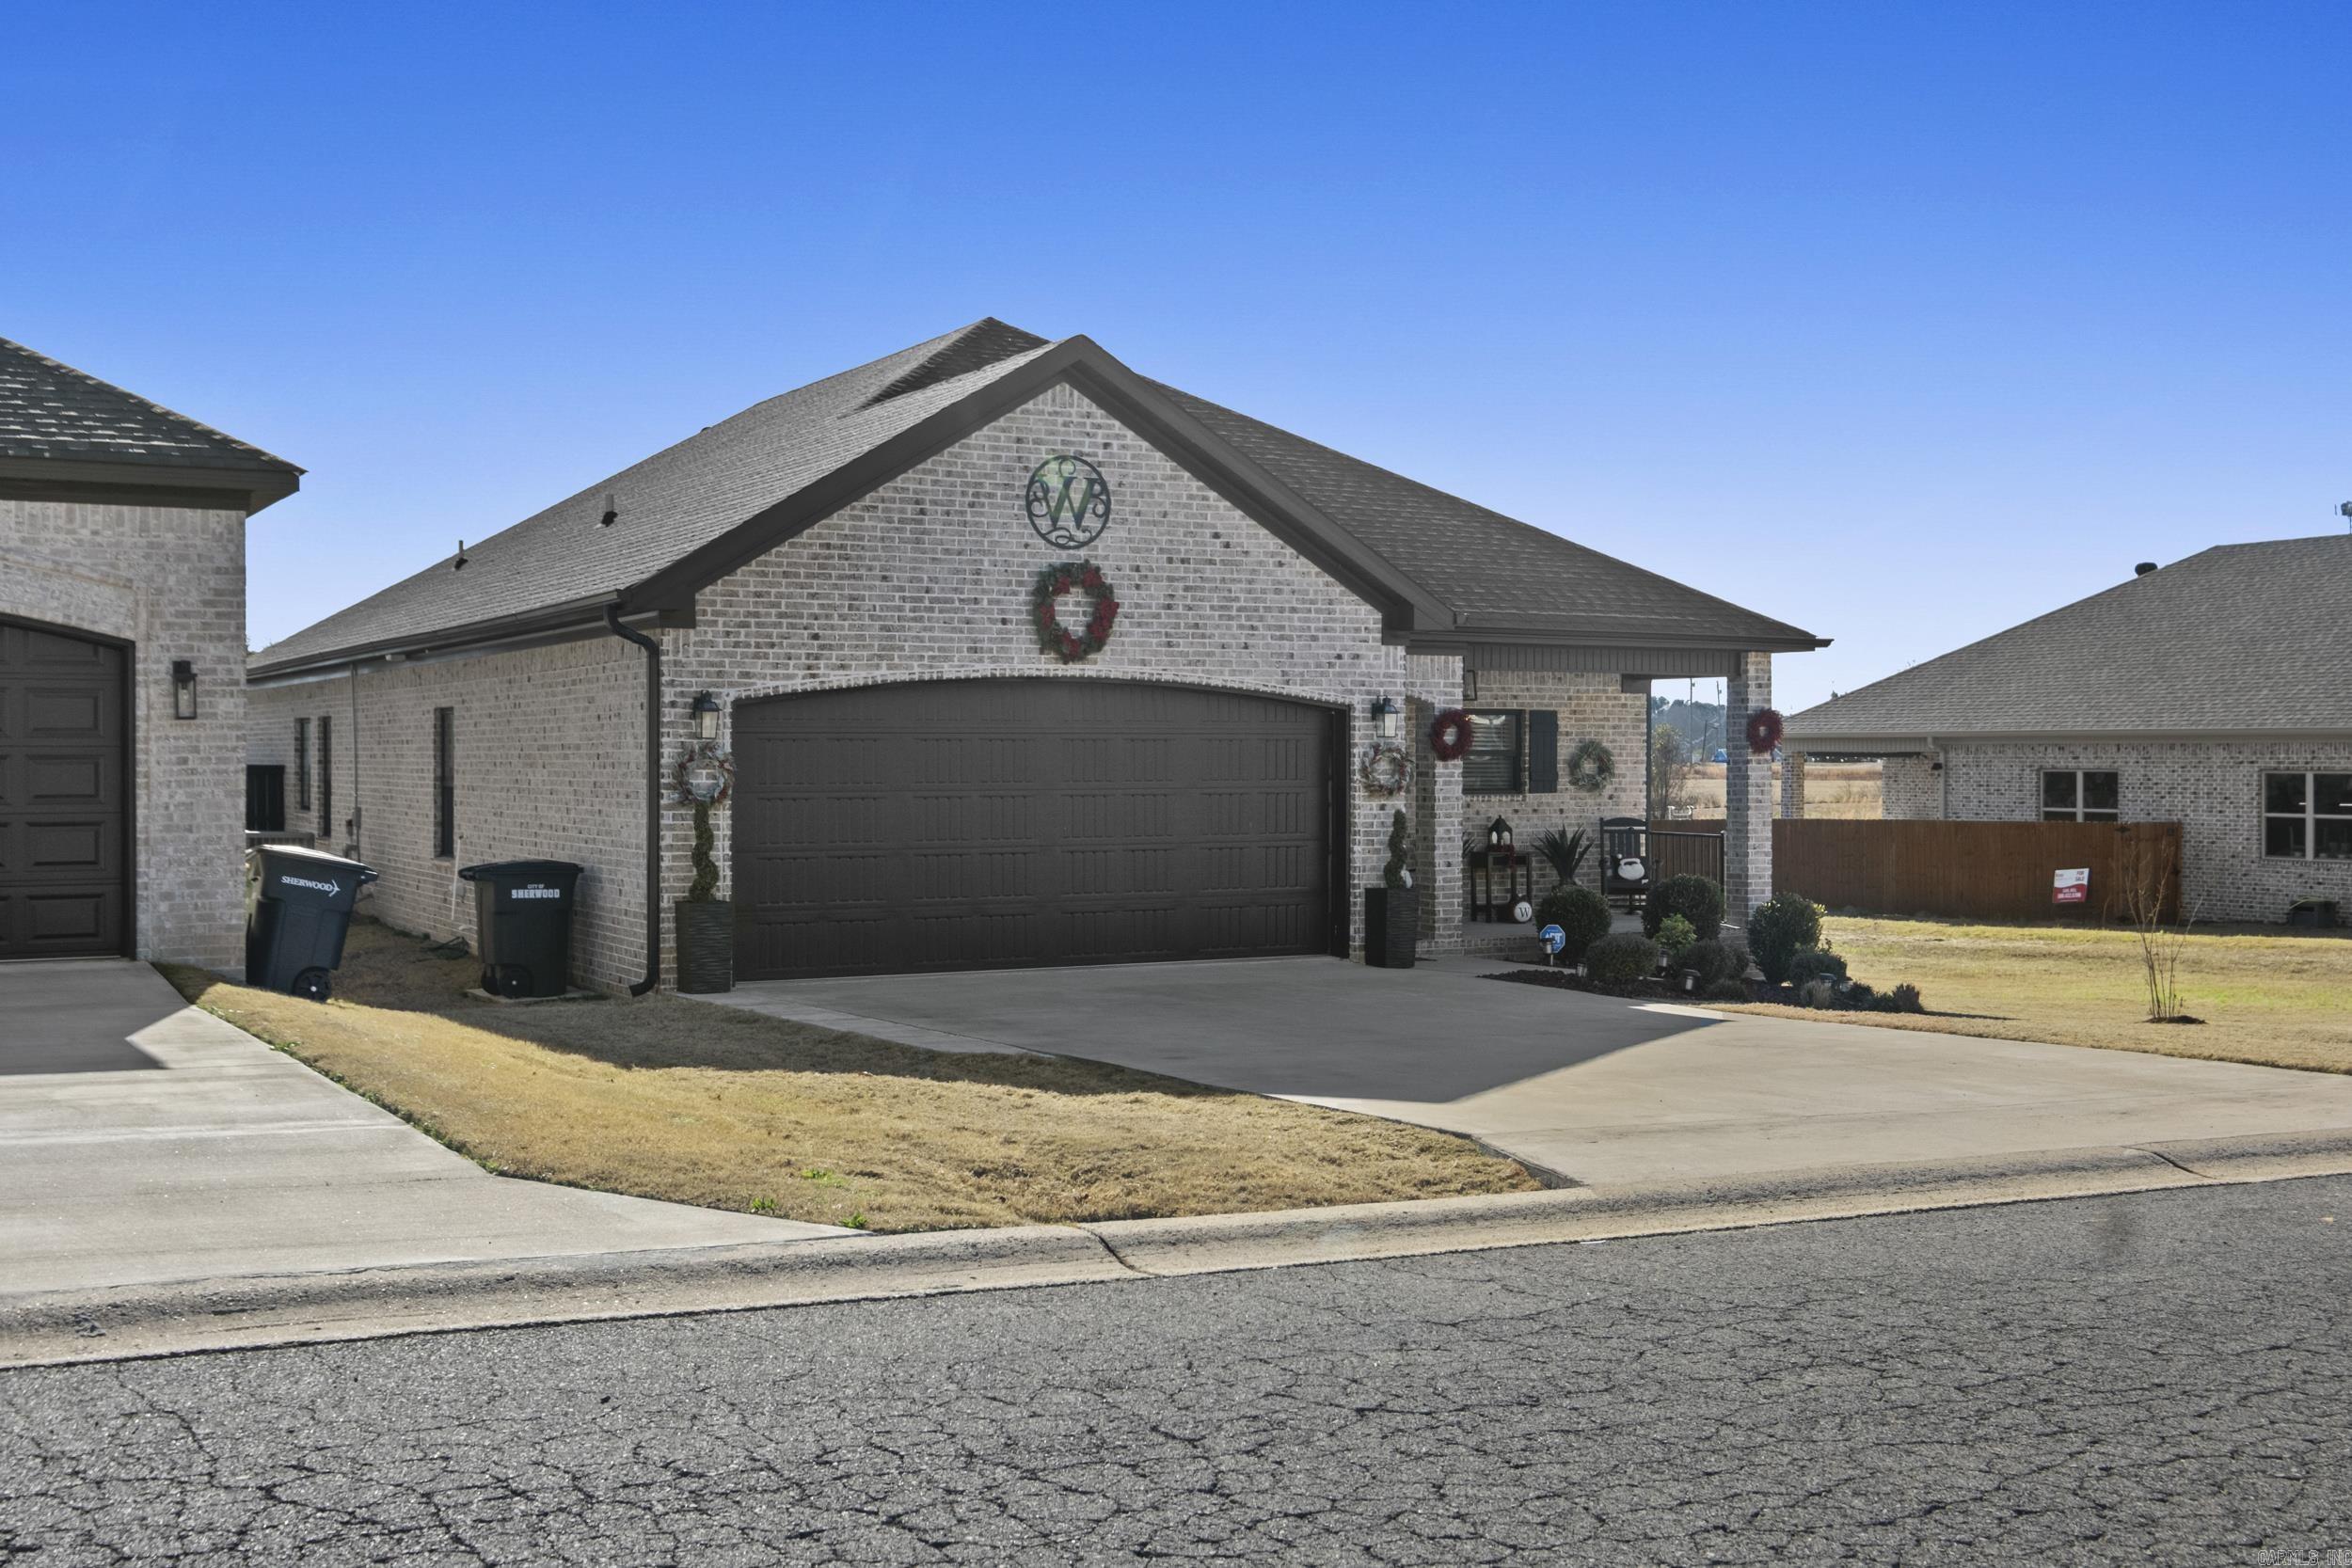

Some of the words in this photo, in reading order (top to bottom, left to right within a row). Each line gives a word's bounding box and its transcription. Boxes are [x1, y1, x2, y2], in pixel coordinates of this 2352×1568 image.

[281, 876, 333, 892] SHERWOOD
[511, 889, 561, 899] SHERWOOD
[1518, 907, 1531, 918] W
